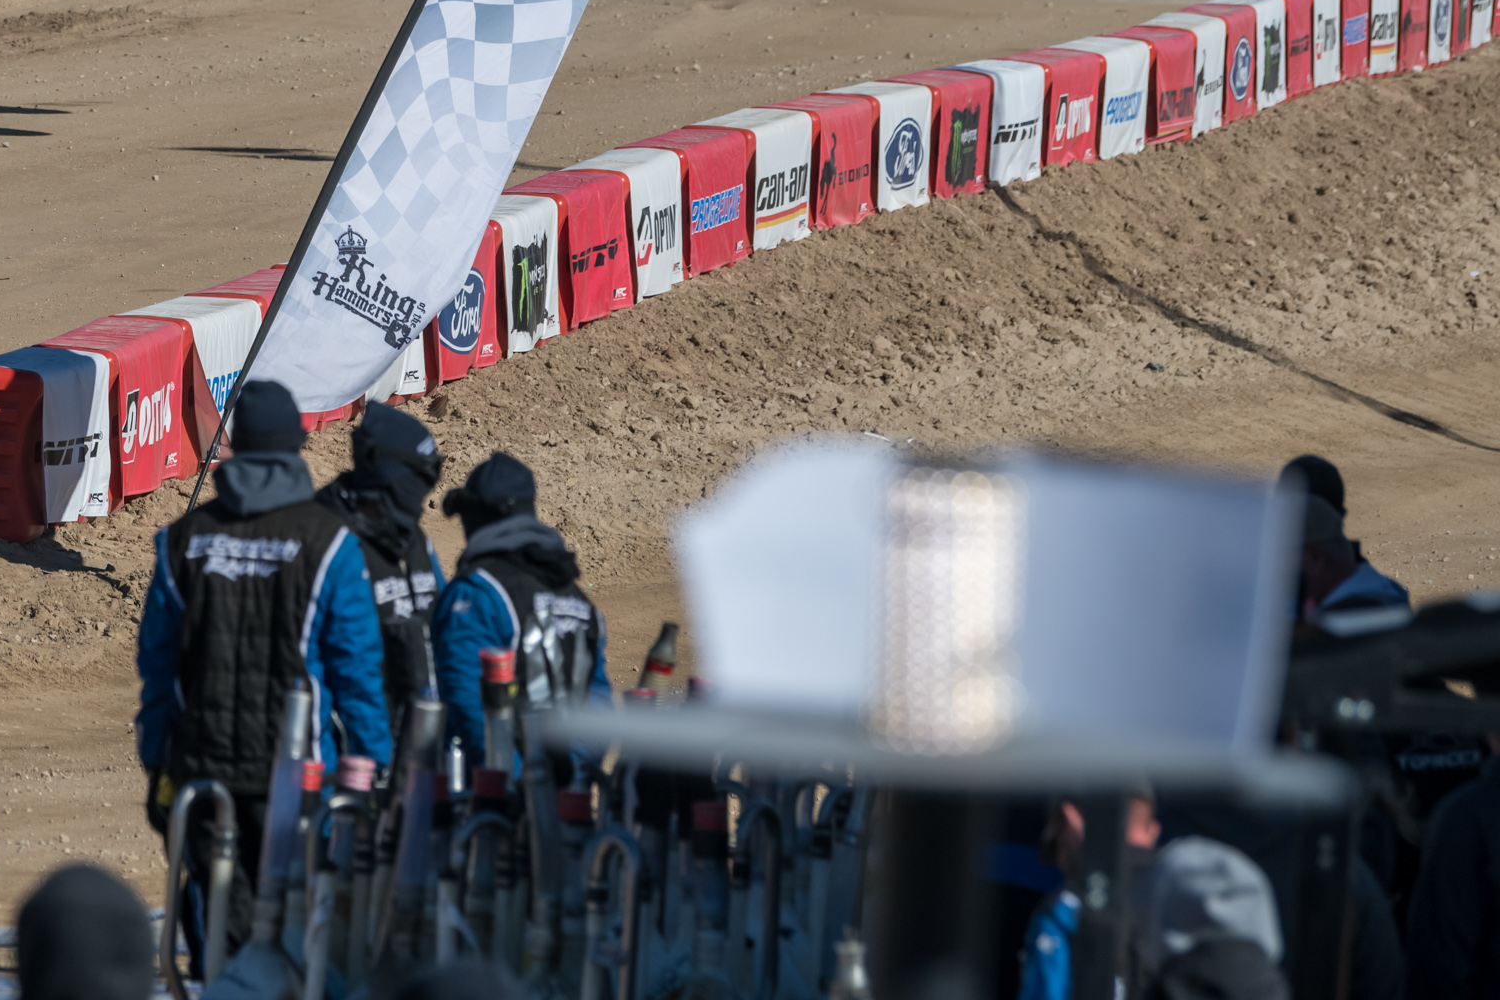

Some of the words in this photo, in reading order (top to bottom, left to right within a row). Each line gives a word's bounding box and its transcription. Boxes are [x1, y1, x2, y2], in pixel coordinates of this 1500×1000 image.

[311, 270, 394, 326] Hammers
[338, 253, 417, 324] King
[450, 282, 482, 340] Ford
